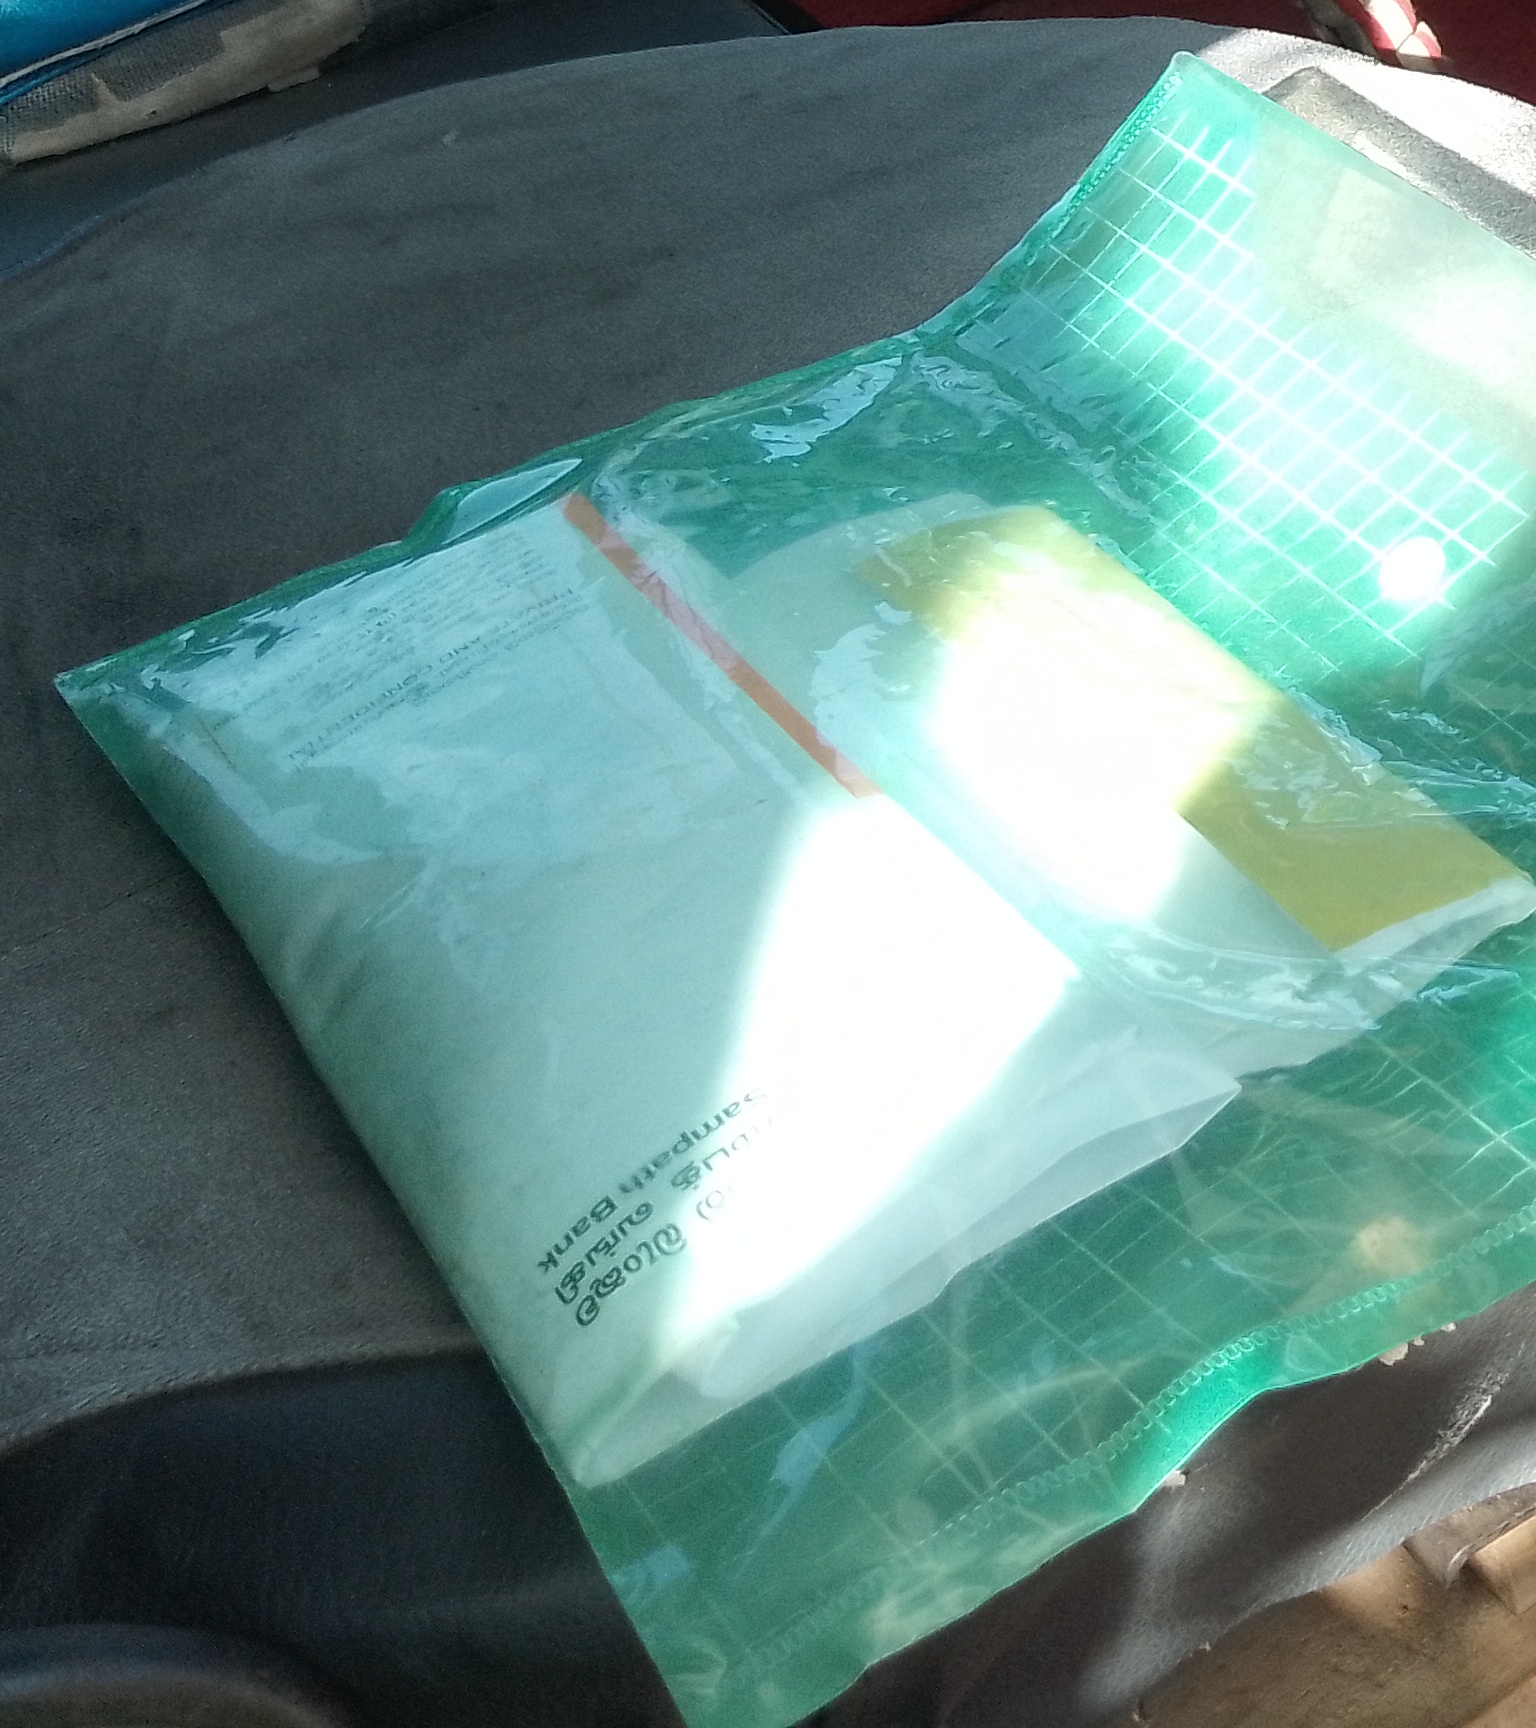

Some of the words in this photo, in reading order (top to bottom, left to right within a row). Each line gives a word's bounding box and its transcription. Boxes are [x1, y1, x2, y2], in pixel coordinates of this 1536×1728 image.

[438, 634, 484, 666] AND
[286, 661, 435, 762] CONFIDENTIAL
[618, 1087, 768, 1194] Sampath
[537, 1195, 618, 1273] Bank
